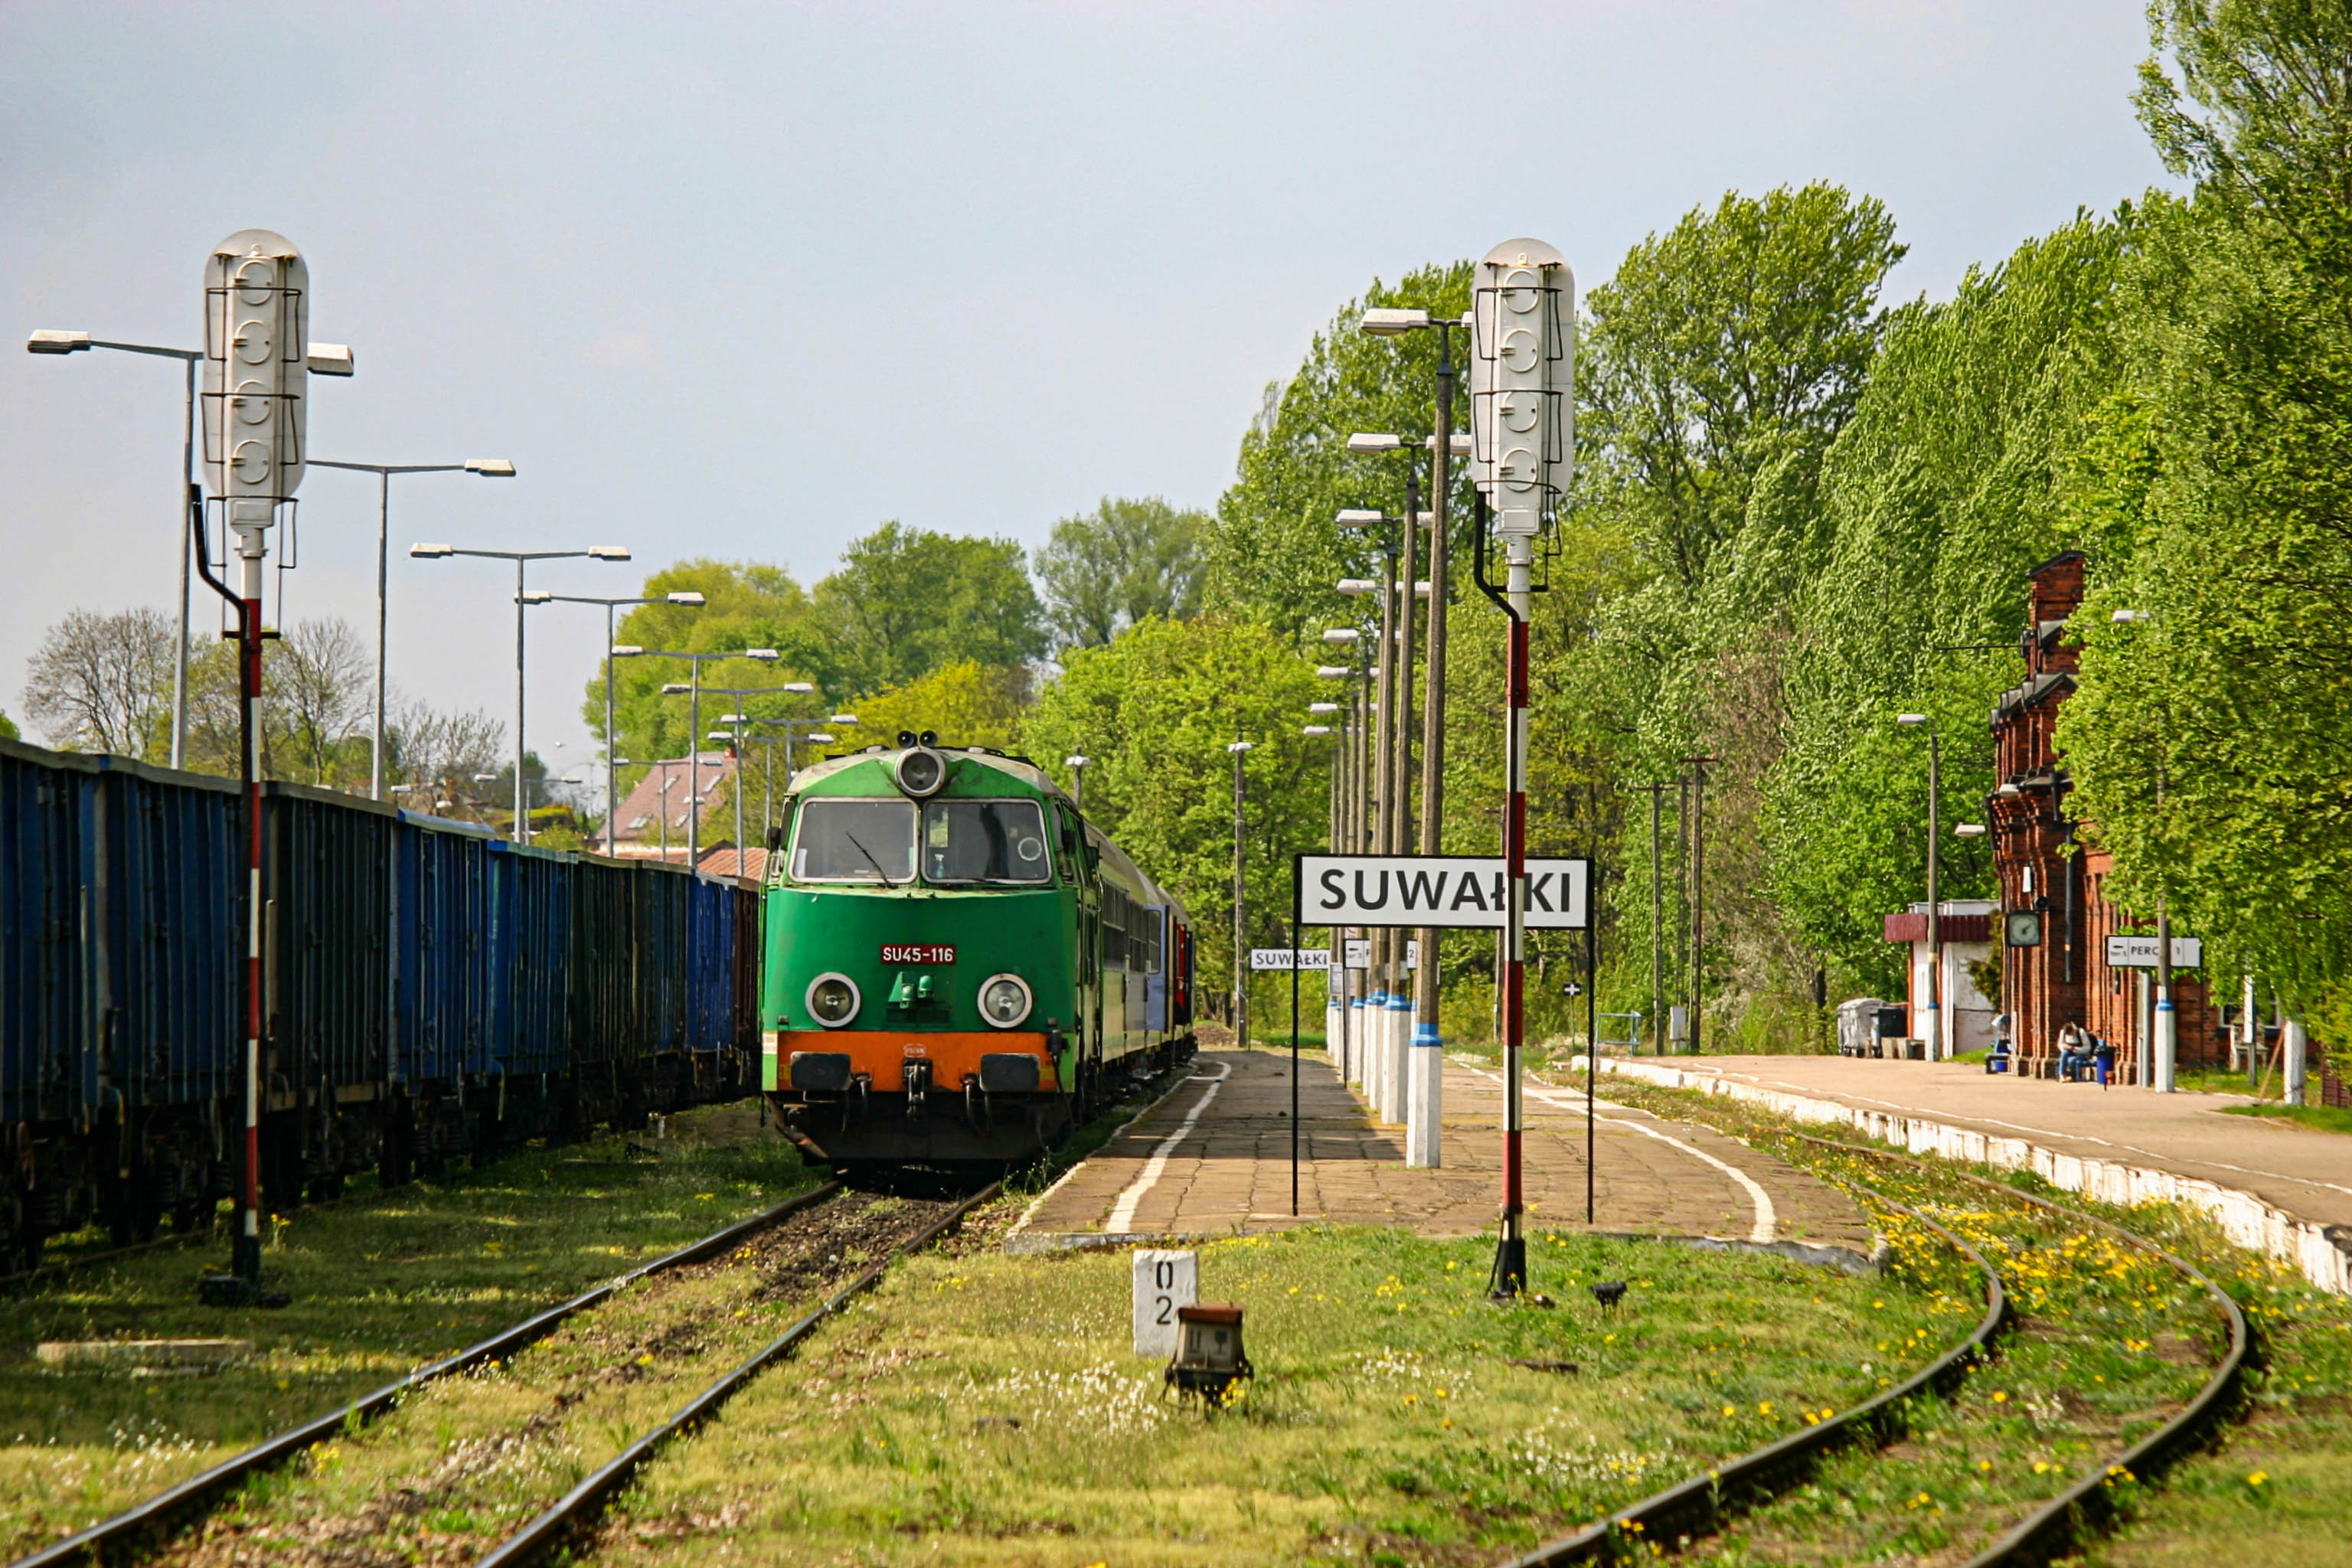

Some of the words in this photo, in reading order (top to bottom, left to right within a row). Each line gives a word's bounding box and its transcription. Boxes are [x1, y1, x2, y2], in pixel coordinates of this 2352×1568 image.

[1320, 868, 1570, 913] SUWAŁKI
[883, 947, 953, 962] SU45-116
[1155, 1260, 1174, 1290] 0
[1155, 1295, 1173, 1325] 2
